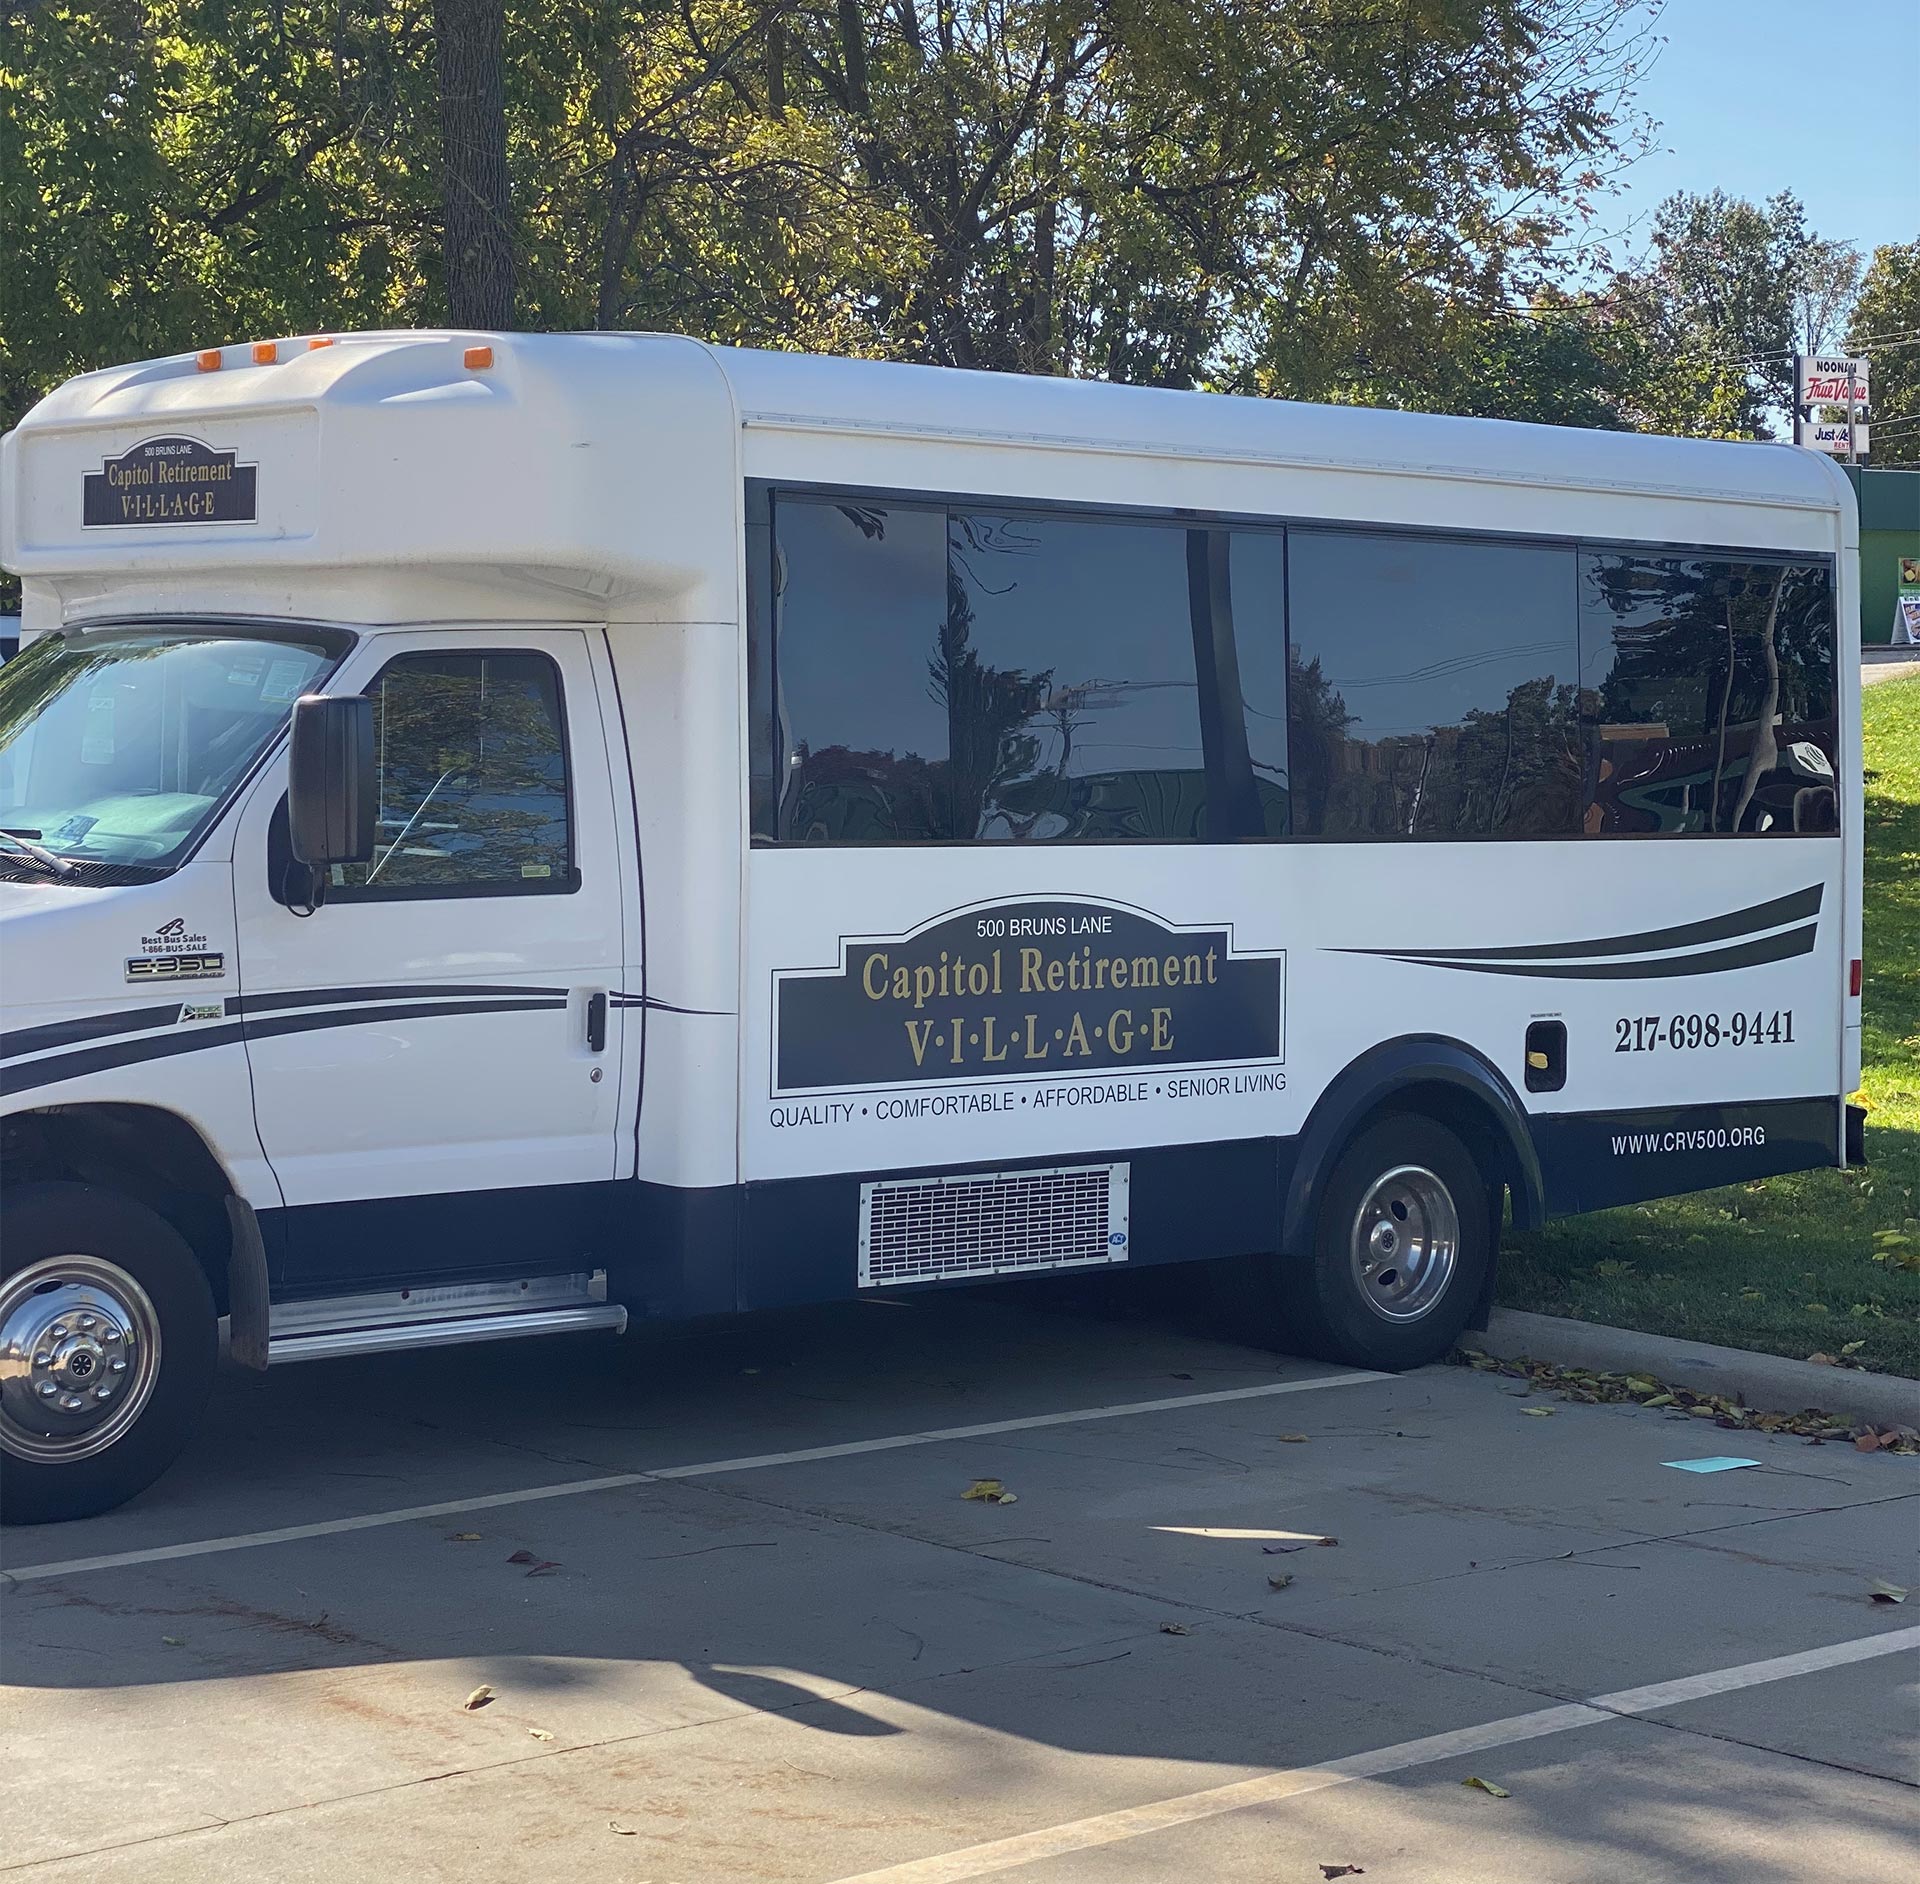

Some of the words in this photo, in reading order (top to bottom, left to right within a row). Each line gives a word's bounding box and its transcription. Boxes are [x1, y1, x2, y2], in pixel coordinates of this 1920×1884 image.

[1815, 427, 1836, 441] Just
[144, 447, 155, 457] 500
[155, 445, 176, 456] BRUNS
[176, 444, 193, 455] LANE
[108, 461, 154, 491] Capitol
[158, 459, 232, 484] Retirement
[141, 936, 162, 945] Best
[163, 935, 181, 944] Bus
[182, 933, 207, 943] Sales
[976, 919, 1005, 938] 500
[1009, 917, 1067, 937] BRUNS
[1070, 916, 1113, 936] LANE
[142, 943, 208, 954] 1-866-BUS-SALE
[862, 949, 1002, 1009] Capitol
[1019, 946, 1218, 994] Retirement
[1614, 1009, 1796, 1053] 217-698-9441
[769, 1102, 855, 1128] QUALITY
[875, 1091, 1014, 1120] COMFORTABLE
[1032, 1082, 1149, 1109] AFFORDABLE
[1167, 1076, 1230, 1099] SENIOR
[1234, 1072, 1287, 1094] LIVING
[1611, 1126, 1766, 1156] WWW.CRV500.ORG
